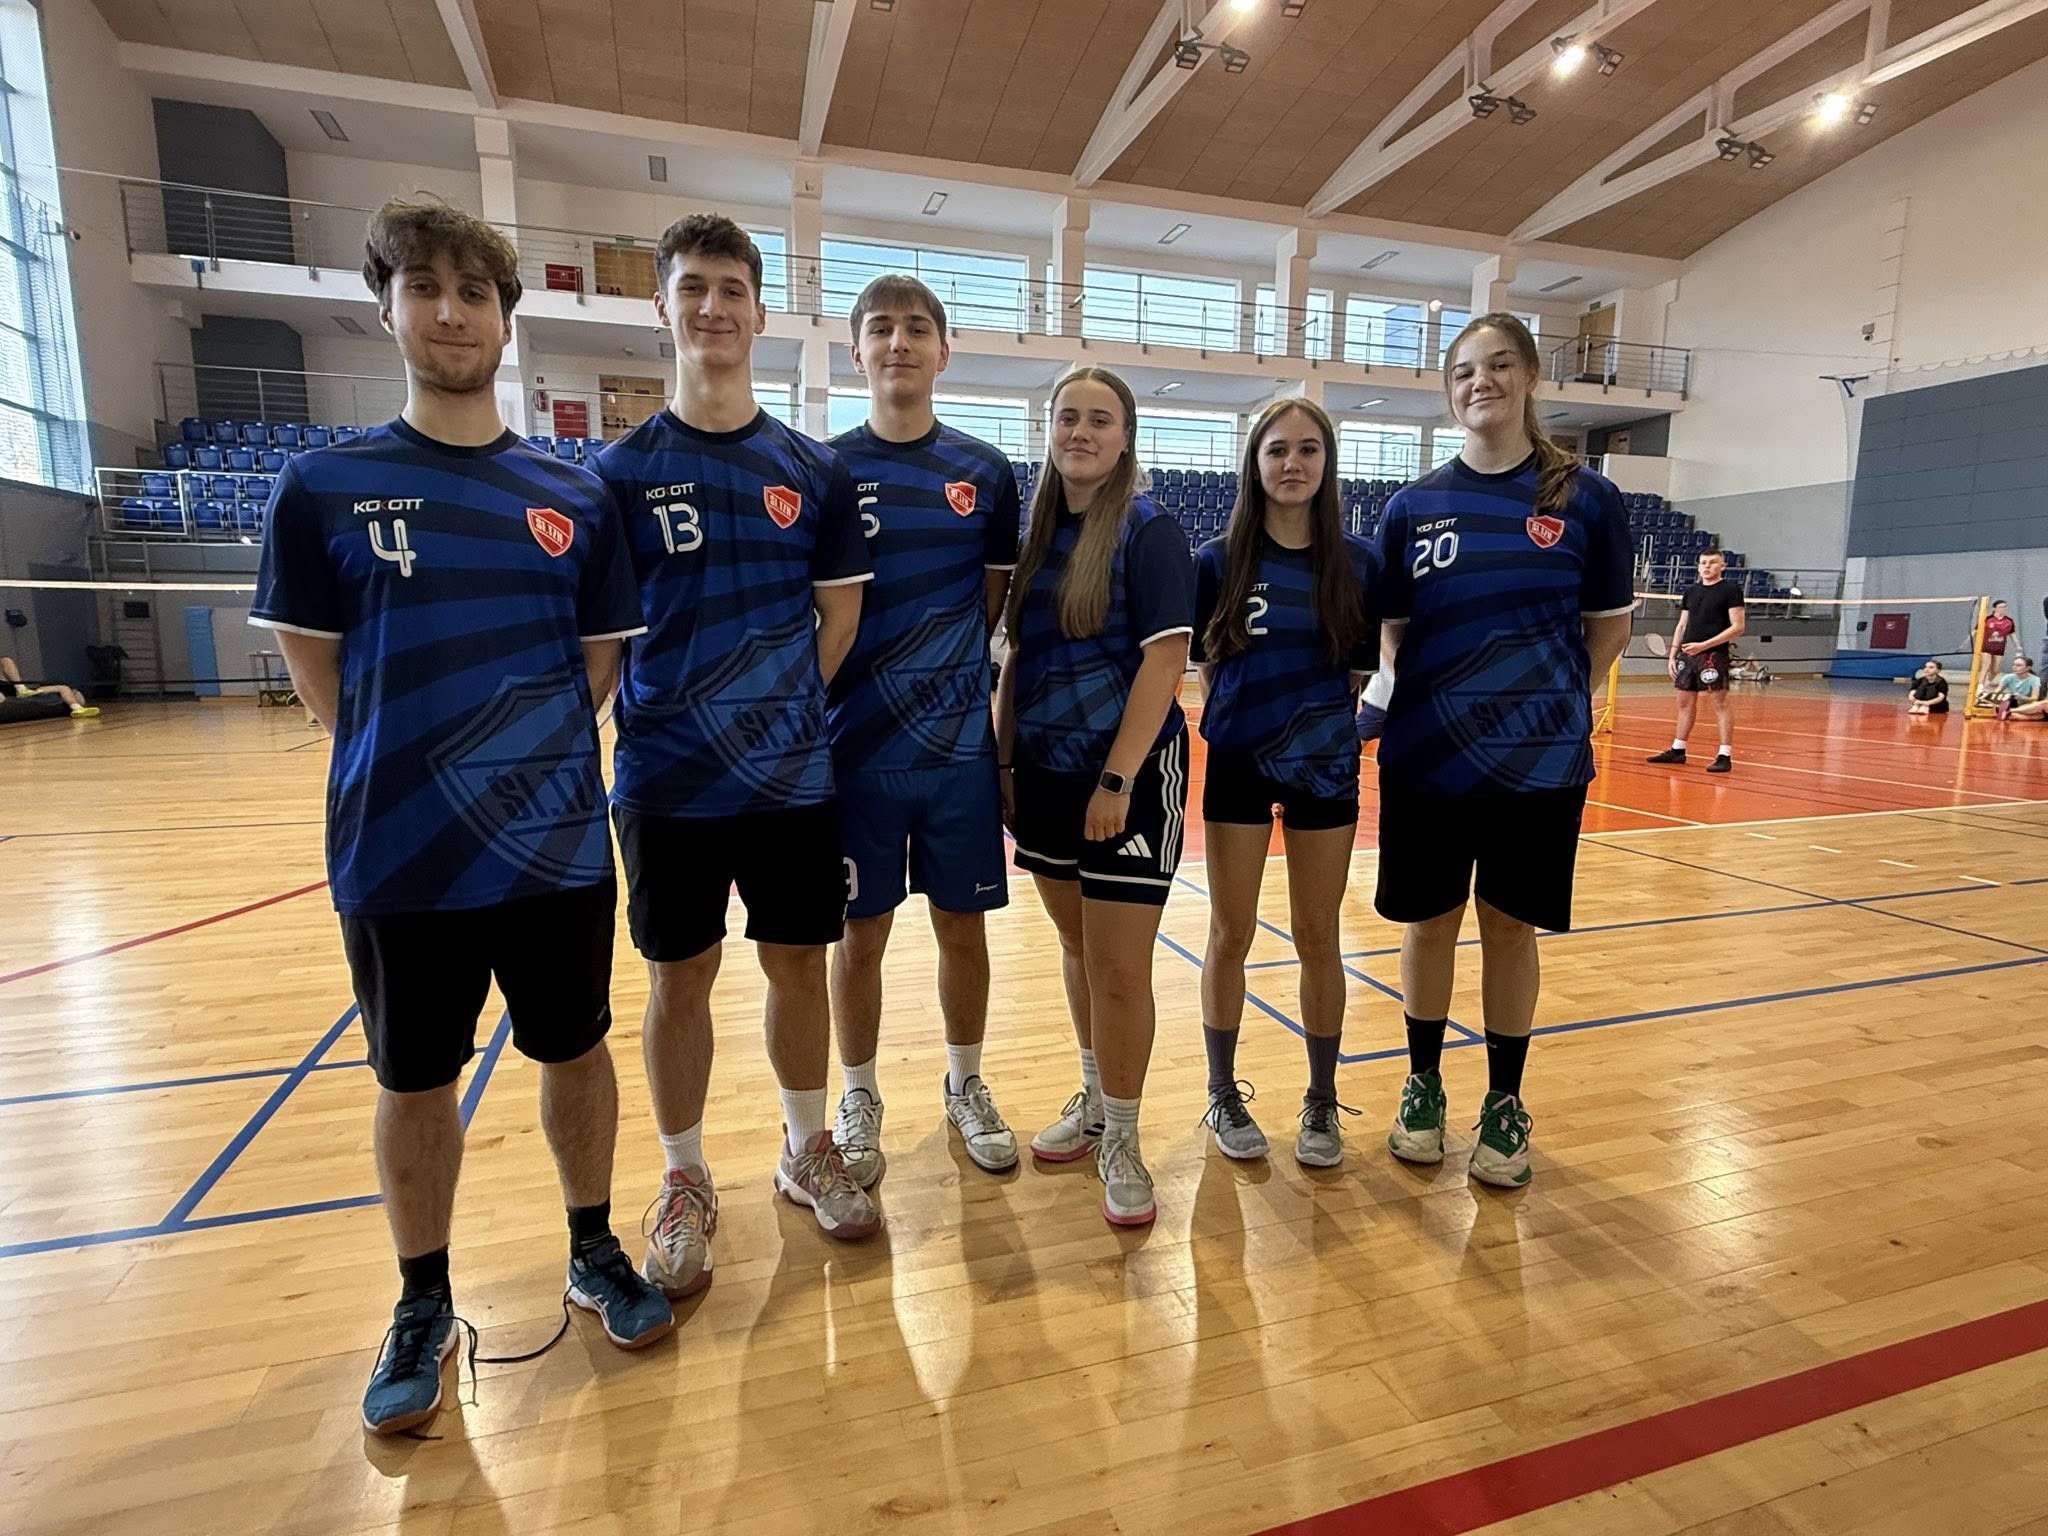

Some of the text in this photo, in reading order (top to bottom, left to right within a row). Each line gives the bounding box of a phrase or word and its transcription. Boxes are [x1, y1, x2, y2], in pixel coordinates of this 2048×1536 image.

[368, 518, 417, 577] 4
[652, 502, 704, 554] 13
[1416, 517, 1458, 535] KOOTT
[1412, 531, 1459, 579] 20
